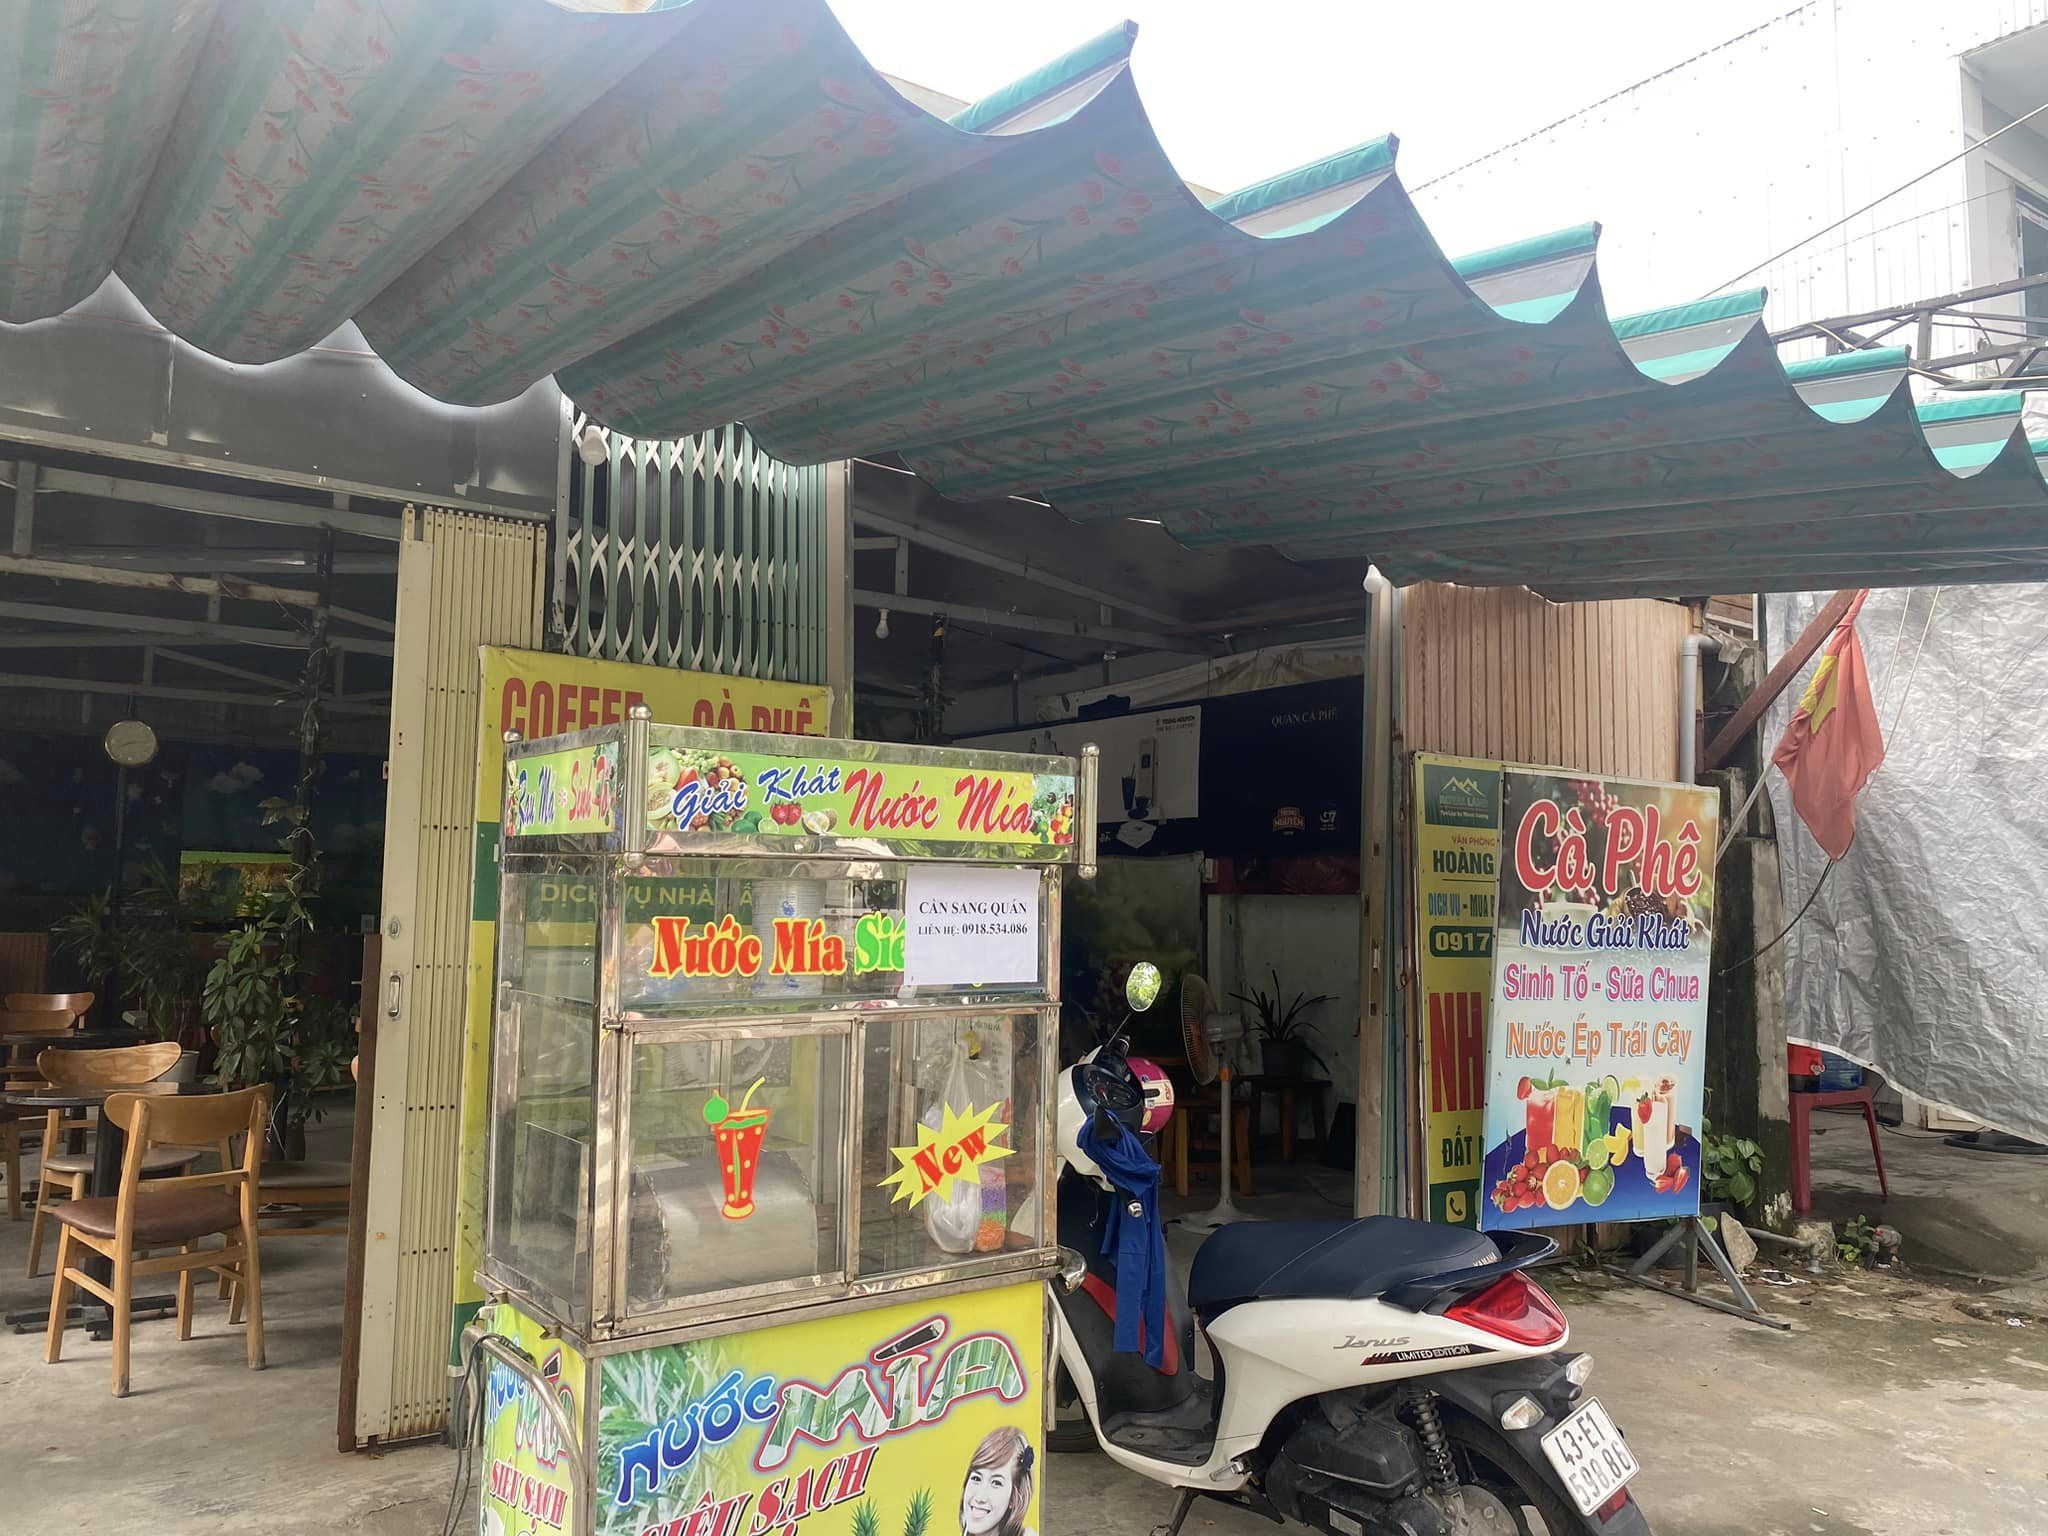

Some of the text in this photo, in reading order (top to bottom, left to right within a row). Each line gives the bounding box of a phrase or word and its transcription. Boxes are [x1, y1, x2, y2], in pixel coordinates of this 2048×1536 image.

[568, 760, 594, 822] Sinh
[672, 764, 1034, 834] Giải Khát Nước Mía
[1433, 847, 1494, 875] HOÀNG
[1515, 798, 1703, 897] Cà Phê
[951, 901, 987, 915] SANG
[1470, 894, 1489, 918] MUA
[649, 913, 763, 980] Nước
[768, 917, 848, 976] Mía
[962, 922, 1029, 936] 0918.534.086
[1435, 931, 1491, 952] 0917
[1519, 908, 1690, 951] Nước Giải Khát
[1503, 962, 1555, 1001] Sinh
[1560, 957, 1593, 1001] Tố
[1606, 964, 1645, 1001] Sữa
[1649, 966, 1700, 1001] Chua
[1428, 991, 1484, 1113] NH
[1506, 1012, 1693, 1067] Nước Ép Trái Cây
[911, 1124, 988, 1195] New
[1442, 1125, 1473, 1168] ĐẤT
[1333, 1335, 1411, 1350] Janus
[1397, 1344, 1471, 1362] LIMITED EDITION
[490, 1457, 568, 1533] SIÊU SẠCH
[750, 1444, 880, 1536] SẠCH
